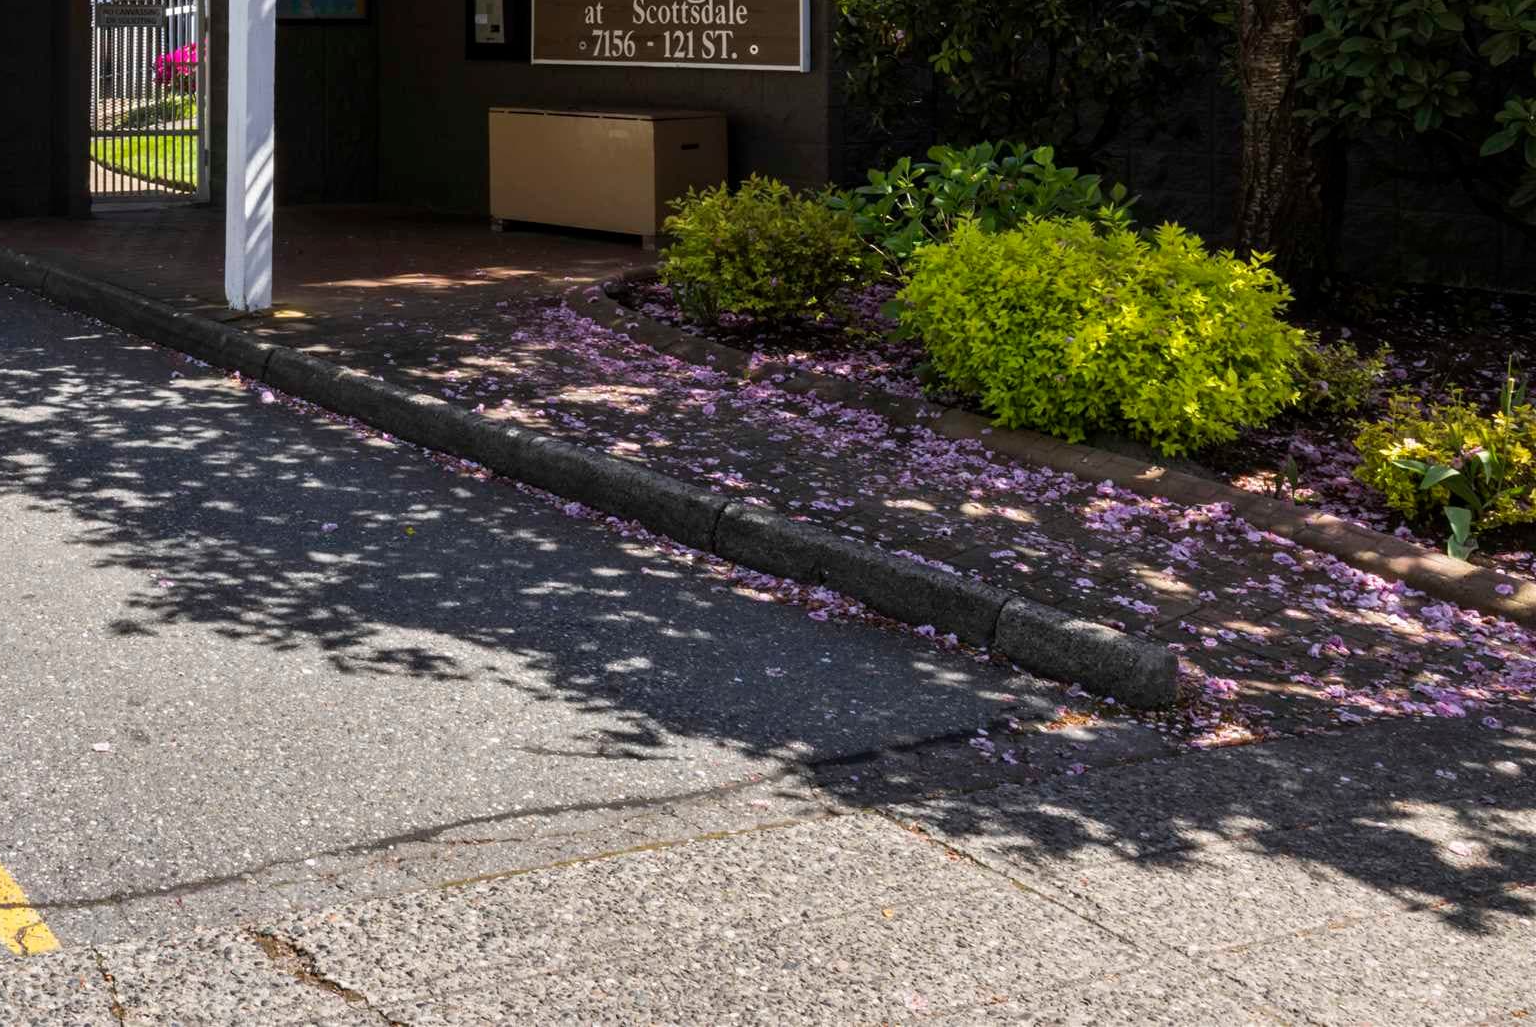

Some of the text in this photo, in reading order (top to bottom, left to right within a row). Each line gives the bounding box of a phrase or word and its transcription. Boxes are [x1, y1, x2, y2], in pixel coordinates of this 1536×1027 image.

[585, 1, 604, 25] at
[592, 29, 636, 58] 7156
[663, 30, 694, 58] 121
[701, 30, 738, 60] ST.
